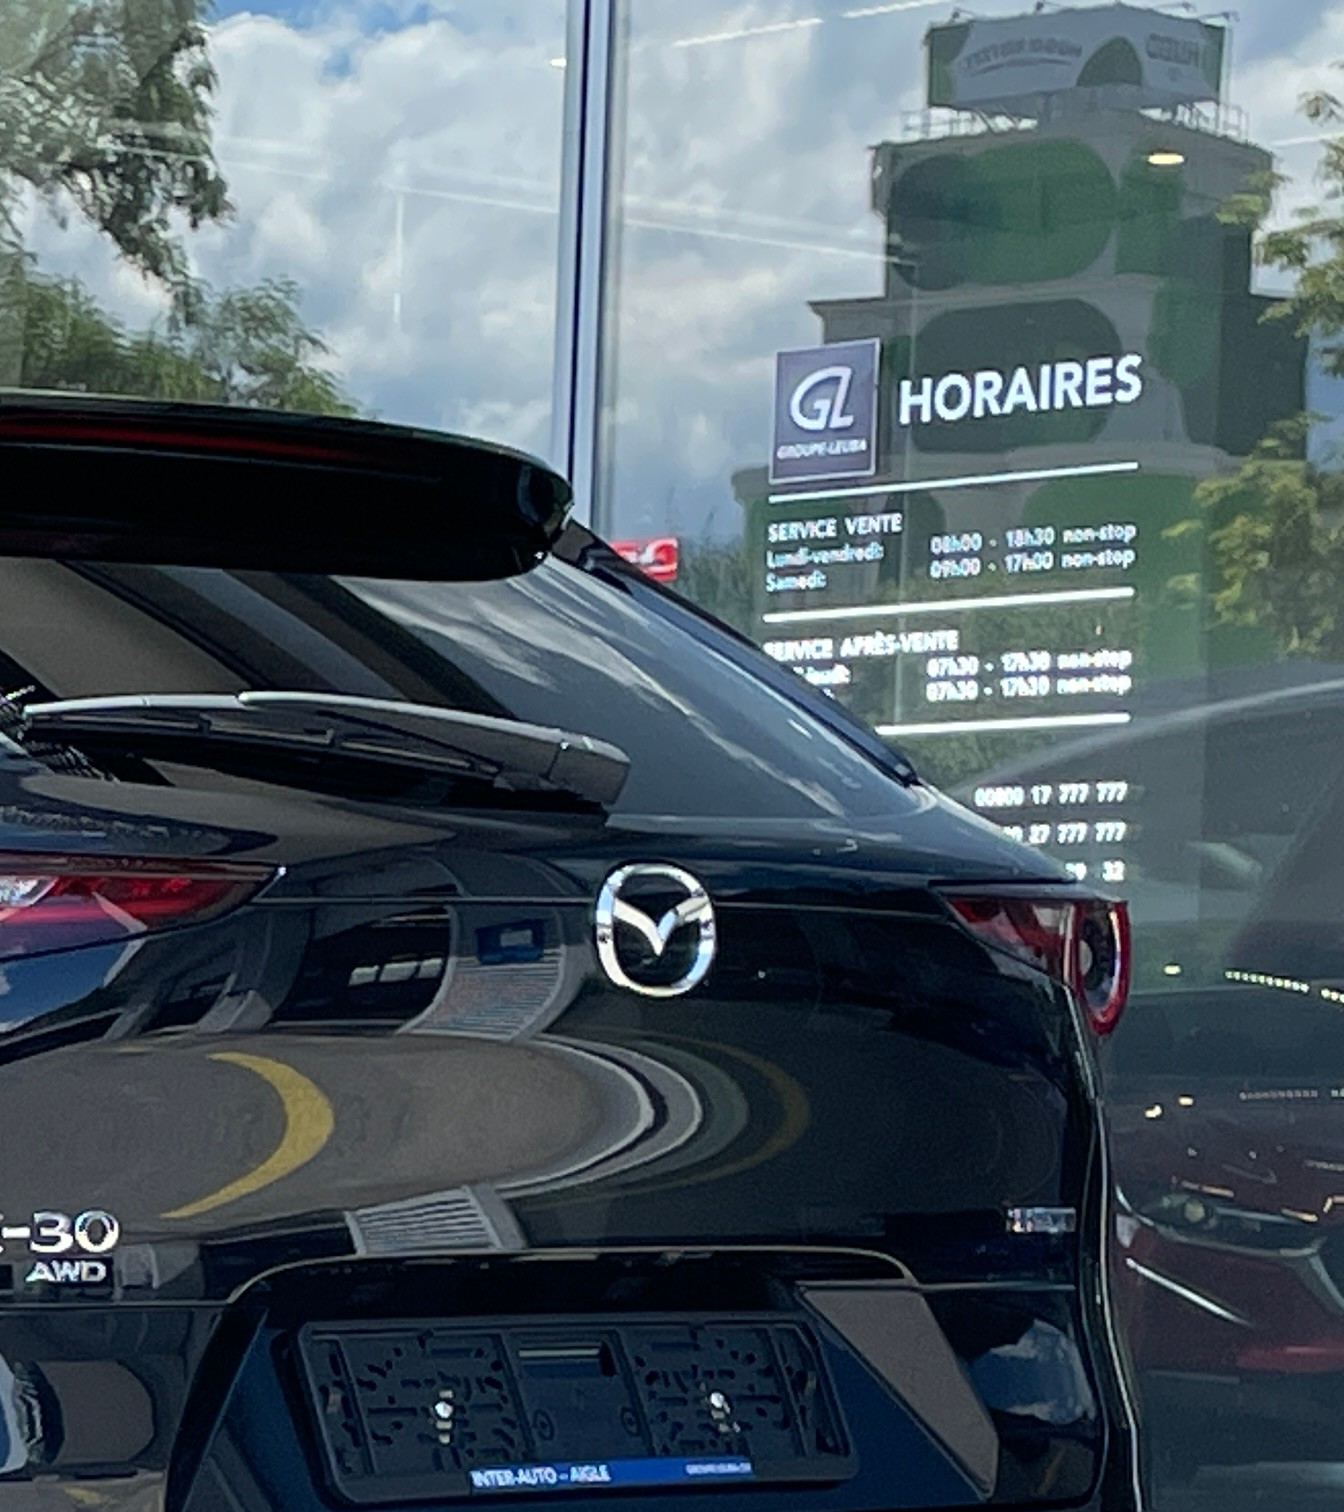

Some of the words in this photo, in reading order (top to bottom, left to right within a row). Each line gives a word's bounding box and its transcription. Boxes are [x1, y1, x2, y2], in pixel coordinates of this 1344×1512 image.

[898, 354, 1143, 425] HORAIRES
[768, 518, 838, 543] SERVICE
[844, 512, 903, 535] VENTE
[840, 629, 959, 658] APRÈS-VENTE
[1030, 784, 1053, 805] 17
[1058, 782, 1089, 804] 777
[1095, 780, 1128, 803] 777
[1057, 821, 1088, 844] 777
[1094, 821, 1127, 843] 777
[25, 1260, 108, 1283] AWD
